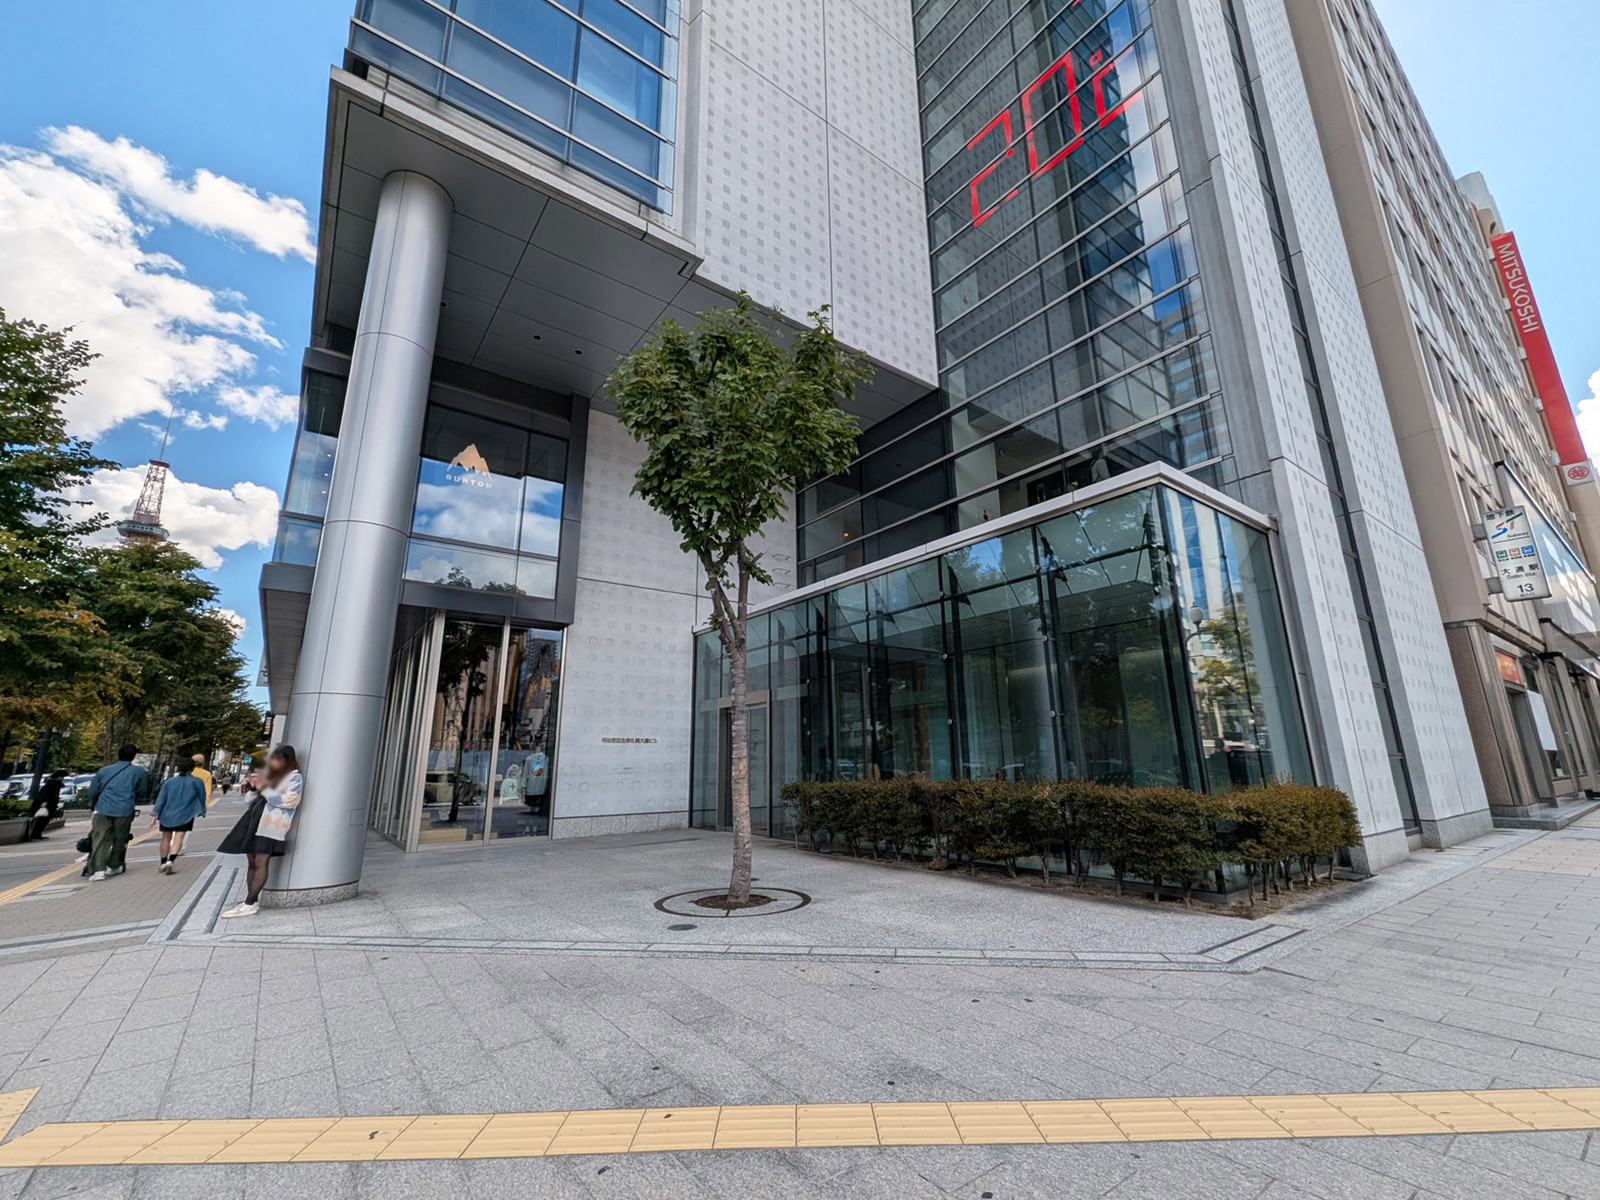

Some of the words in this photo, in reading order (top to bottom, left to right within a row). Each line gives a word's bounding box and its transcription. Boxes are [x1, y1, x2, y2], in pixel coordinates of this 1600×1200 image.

[1497, 242, 1540, 333] MITSUKOSHI
[445, 473, 492, 489] BURTON
[1517, 583, 1534, 593] 13
